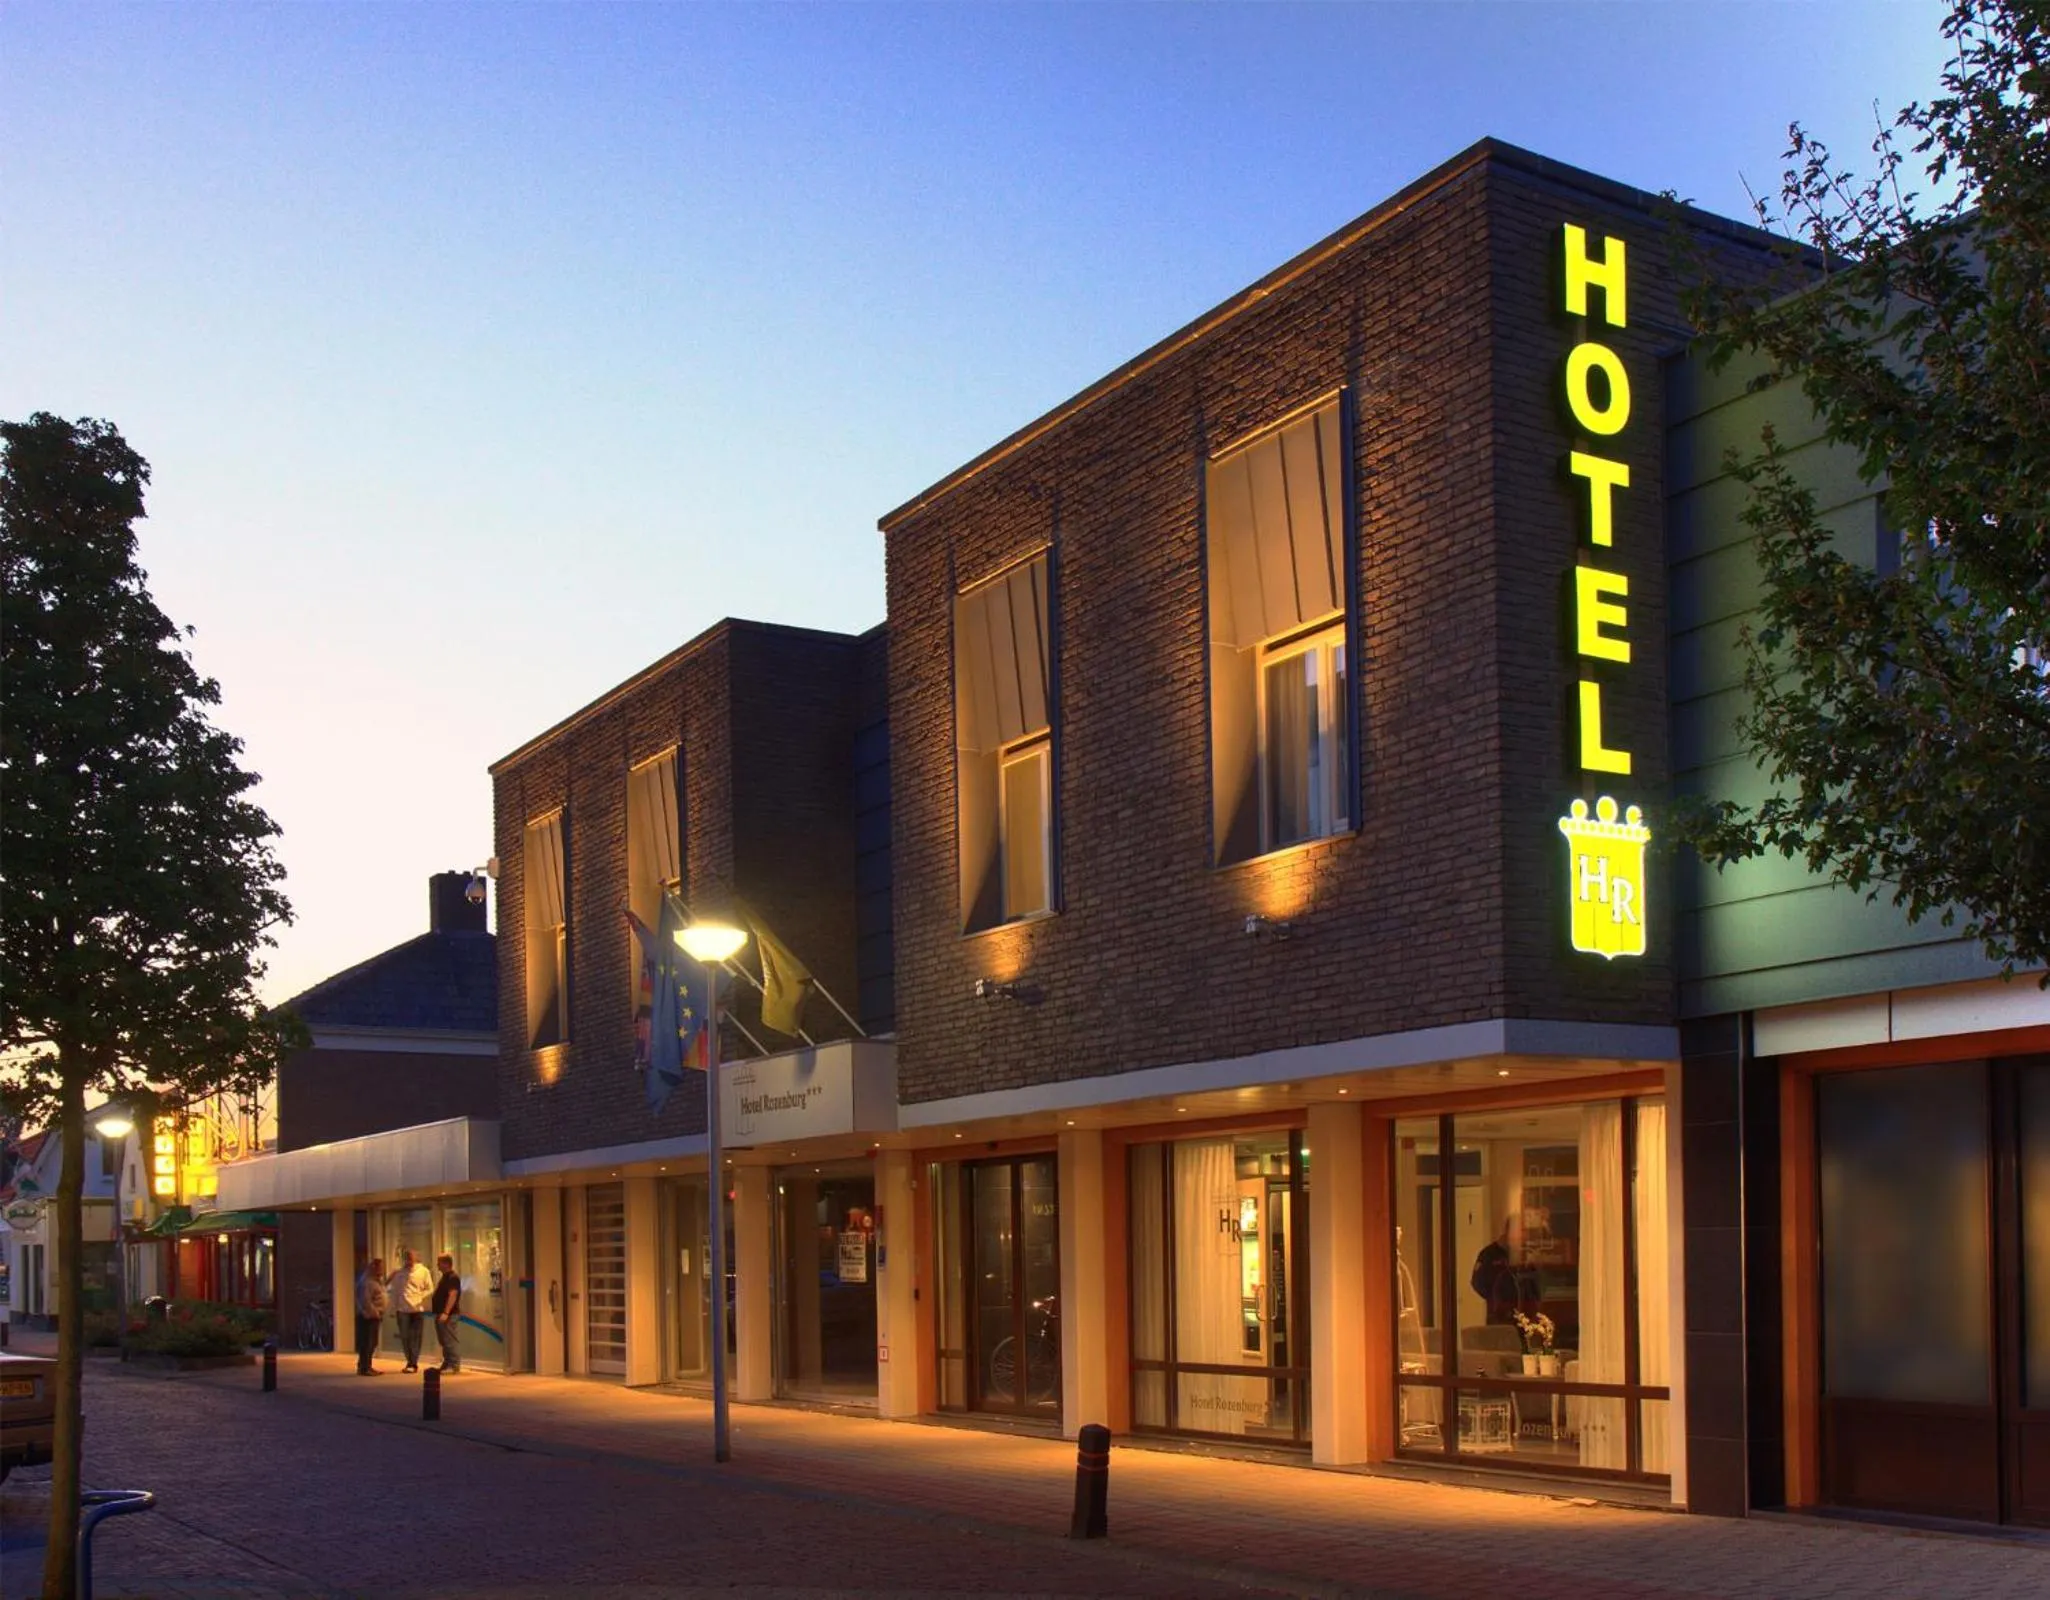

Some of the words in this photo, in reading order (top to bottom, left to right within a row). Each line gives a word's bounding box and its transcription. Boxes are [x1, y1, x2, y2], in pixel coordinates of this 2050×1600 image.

[1564, 222, 1631, 775] HOTEL
[1579, 854, 1640, 925] HR
[741, 1096, 762, 1114] Hotel
[1219, 1209, 1243, 1243] HR
[1191, 1395, 1215, 1410] Hotel
